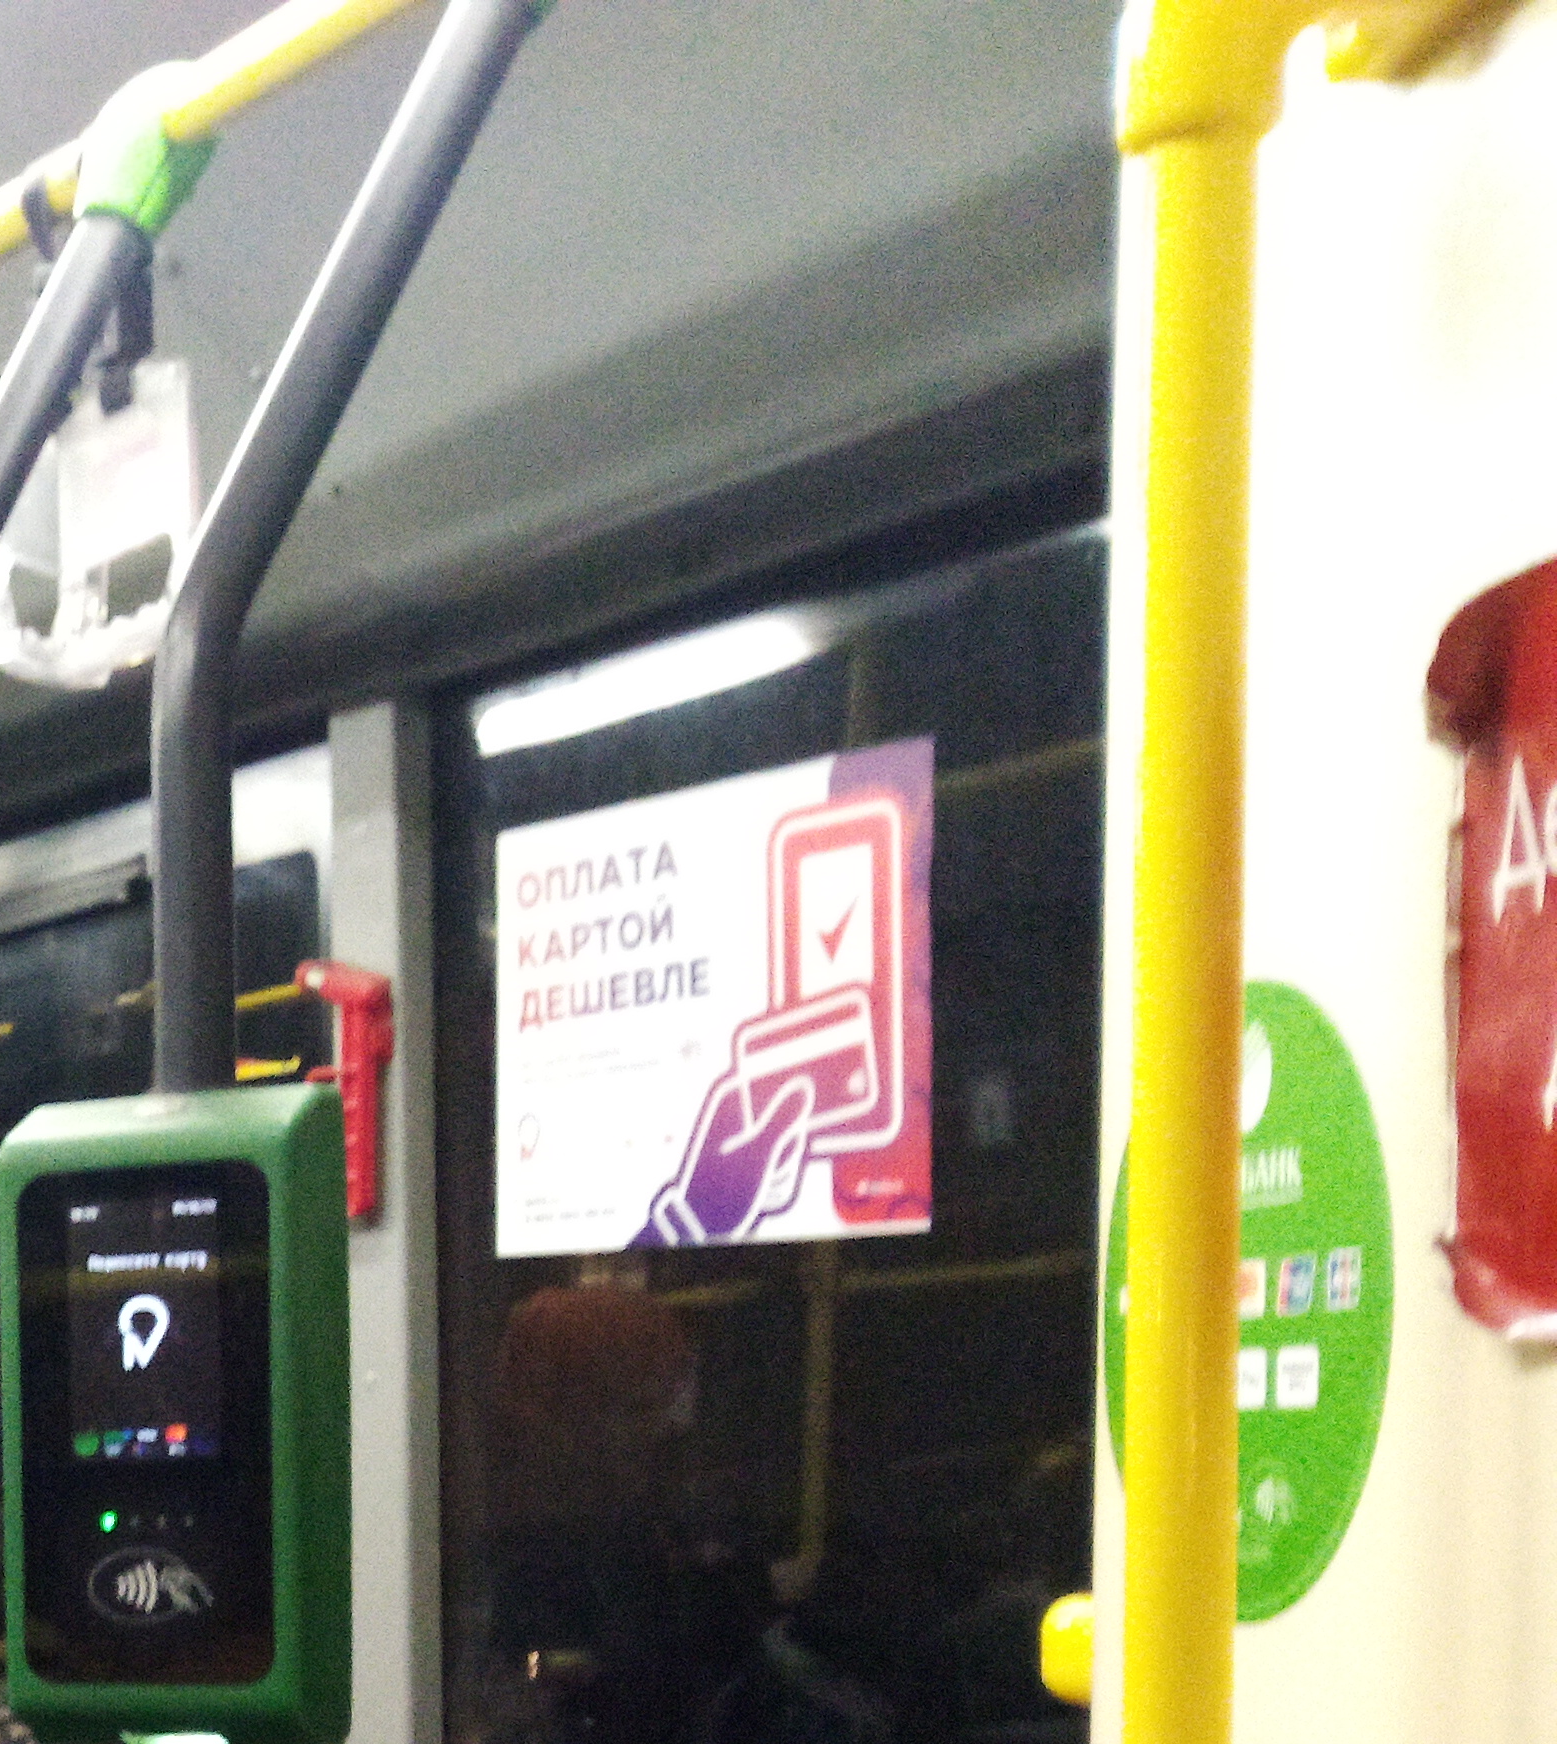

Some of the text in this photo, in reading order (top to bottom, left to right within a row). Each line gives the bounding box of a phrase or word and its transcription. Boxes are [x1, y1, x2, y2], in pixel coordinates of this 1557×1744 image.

[517, 840, 678, 910] ОПЛАТА
[518, 893, 674, 970] КАРТОЙ
[518, 956, 711, 1033] ДЕШЕВЛЕ
